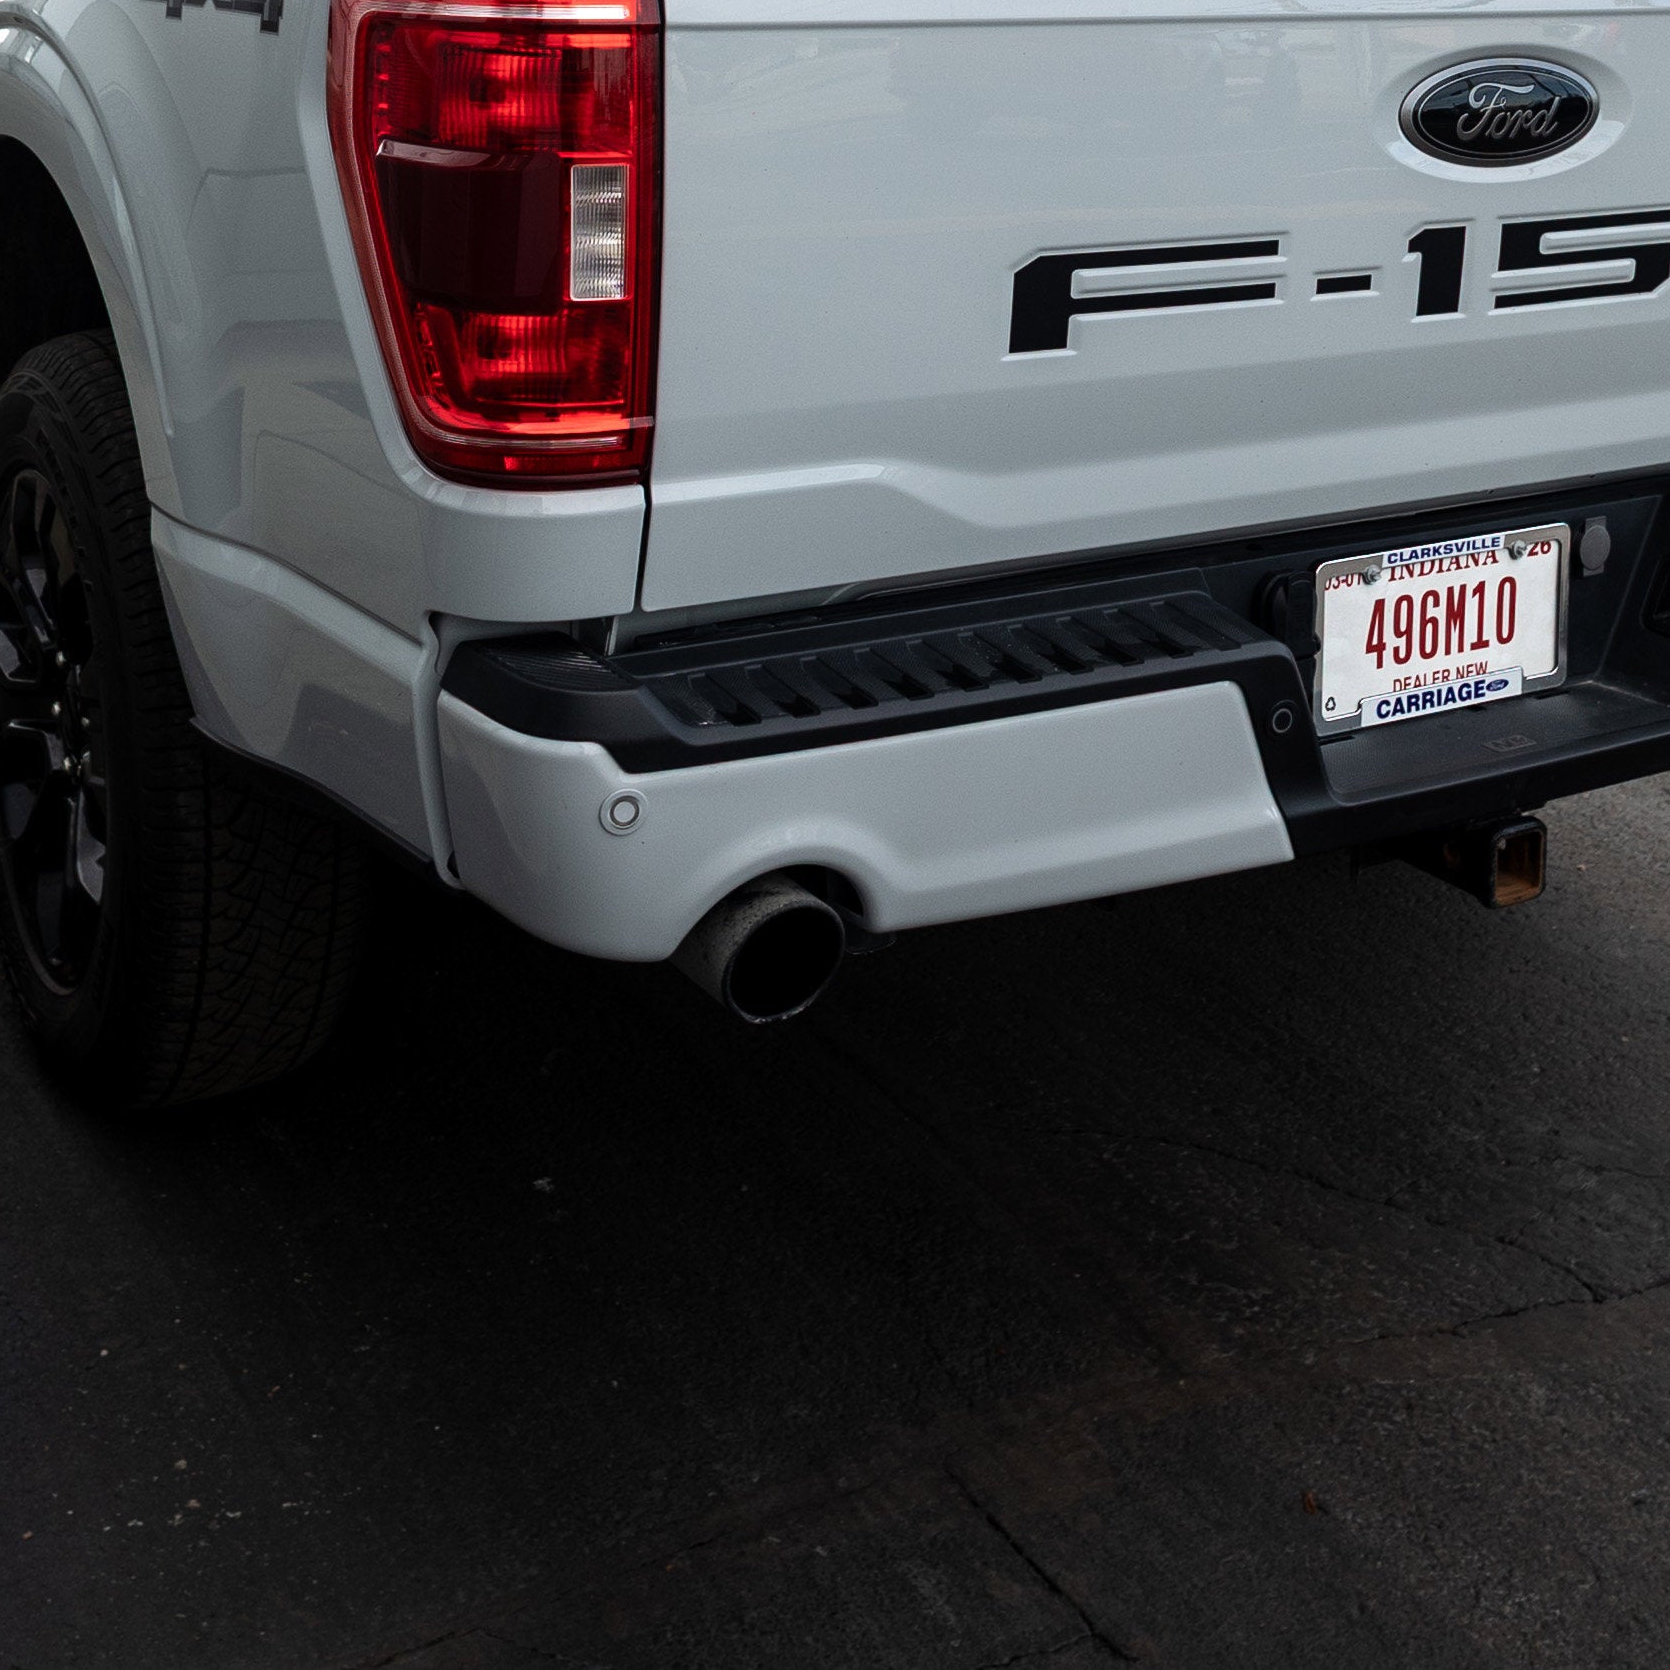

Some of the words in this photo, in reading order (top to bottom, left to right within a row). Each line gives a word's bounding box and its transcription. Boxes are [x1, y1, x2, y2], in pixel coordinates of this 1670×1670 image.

[1456, 82, 1561, 141] Ford
[1387, 536, 1501, 565] CLARKSVILLE
[1388, 549, 1499, 582] INDIANA
[1365, 576, 1517, 670] 496M10
[1393, 668, 1451, 693] DEALER
[1456, 661, 1489, 680] NEW
[1376, 679, 1486, 720] CARRIAGE
